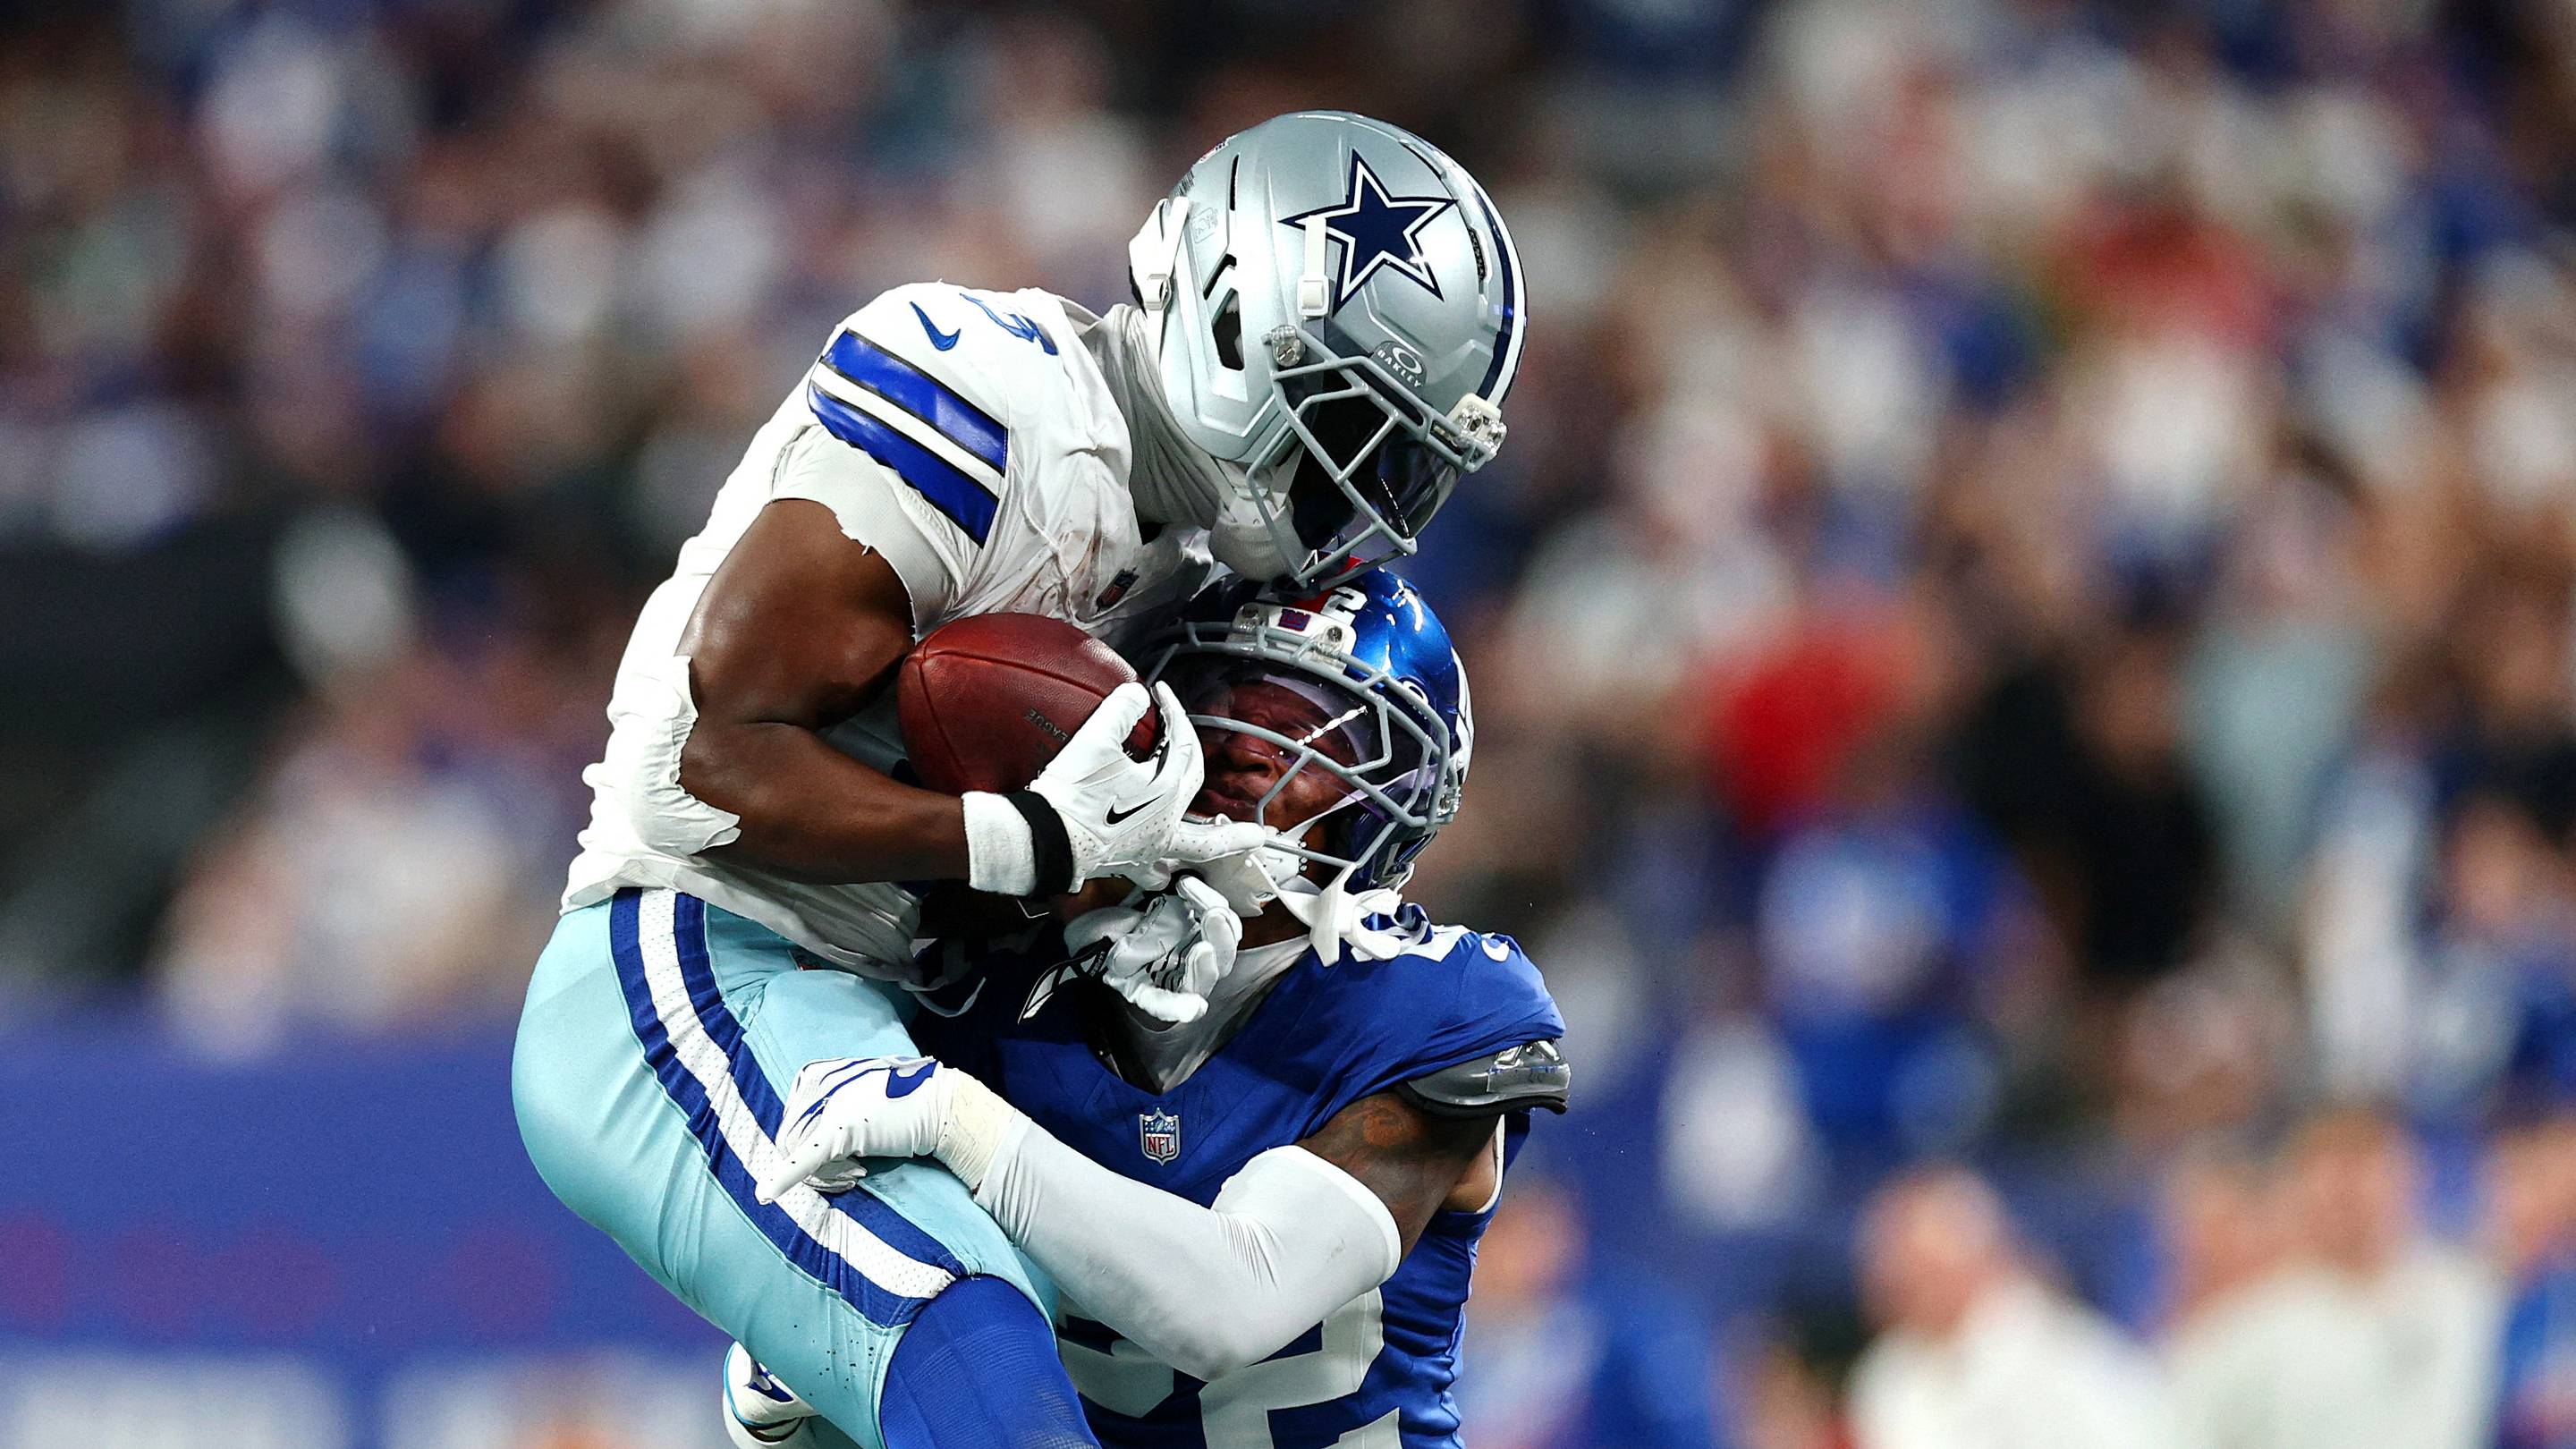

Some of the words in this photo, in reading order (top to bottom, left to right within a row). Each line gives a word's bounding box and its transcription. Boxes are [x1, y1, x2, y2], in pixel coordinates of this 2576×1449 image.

[1377, 349, 1422, 387] OAKLEY
[1024, 708, 1069, 741] EAGUE
[1146, 1136, 1174, 1156] NFL
